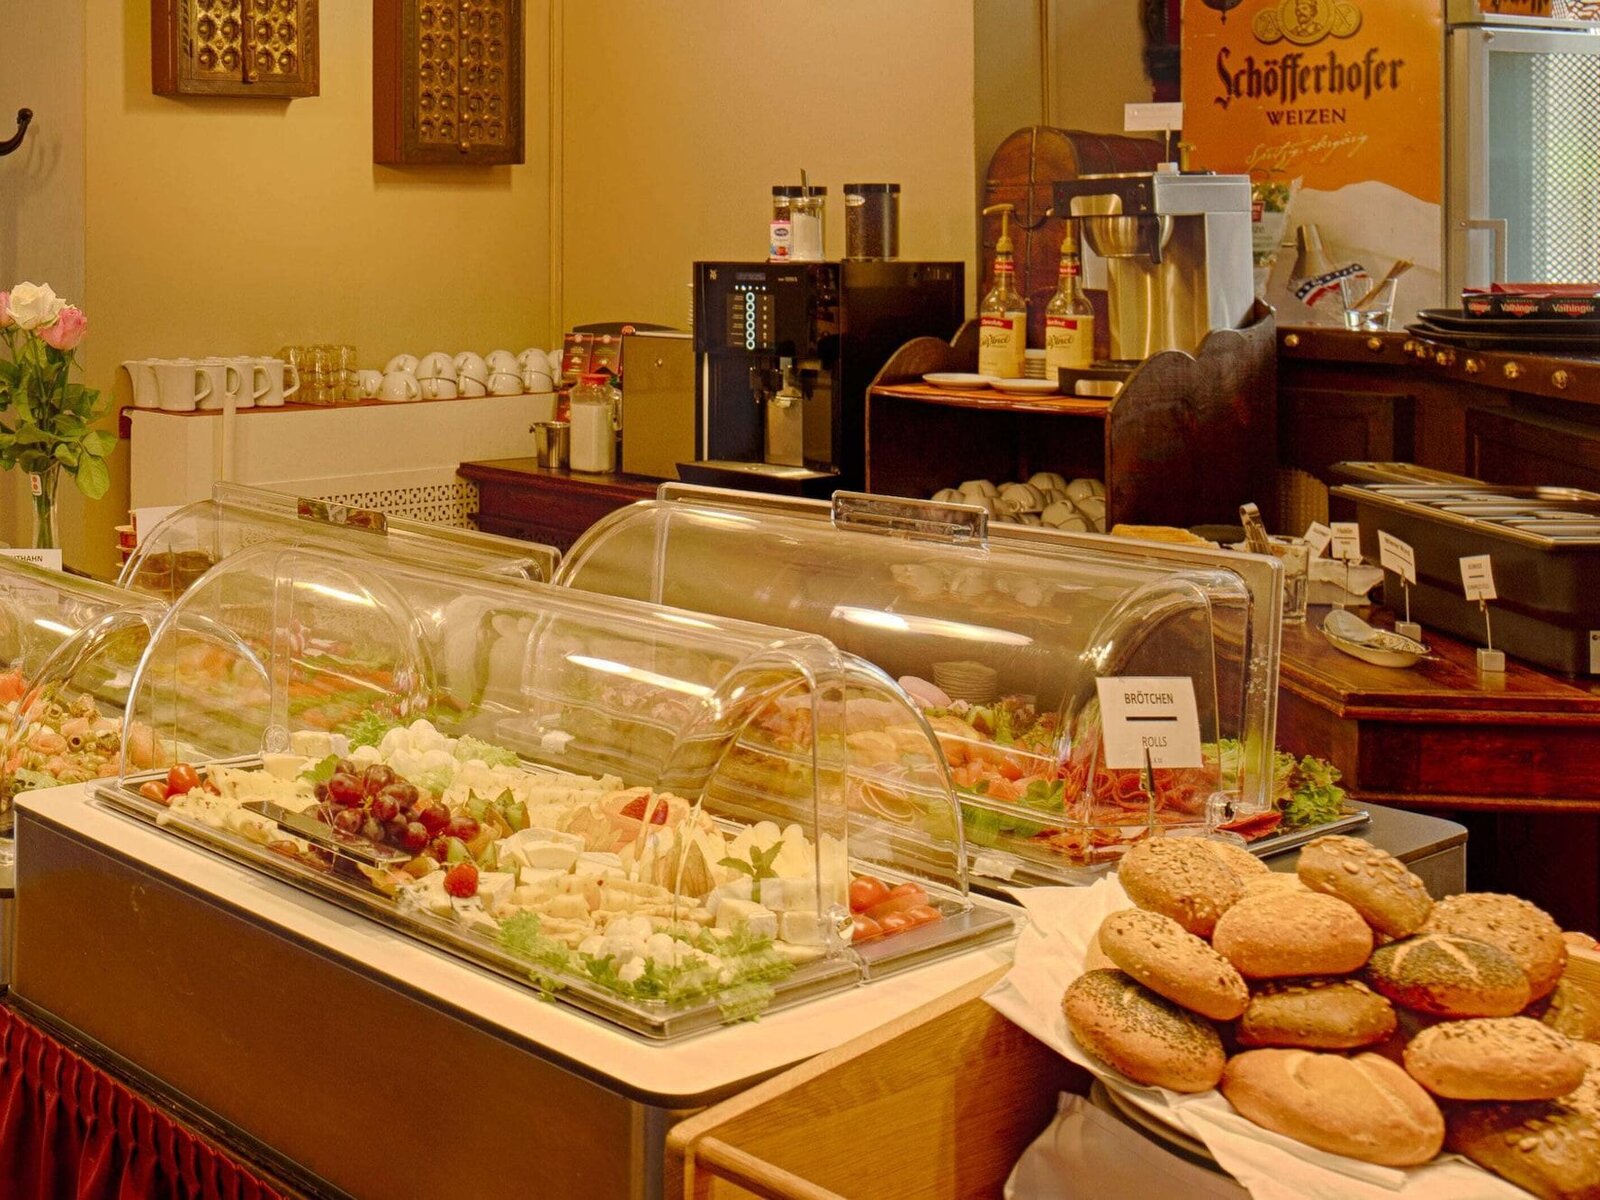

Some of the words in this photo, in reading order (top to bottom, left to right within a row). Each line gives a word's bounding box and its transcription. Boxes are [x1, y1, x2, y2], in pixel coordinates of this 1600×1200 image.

[1214, 47, 1404, 110] Schöfferhofer
[1266, 108, 1347, 126] WEIZEN
[1501, 303, 1539, 314] Vaihinger
[1552, 303, 1596, 314] Vaihinger
[1124, 691, 1174, 705] BRÖTCHEN
[1141, 736, 1168, 748] ROLLS
